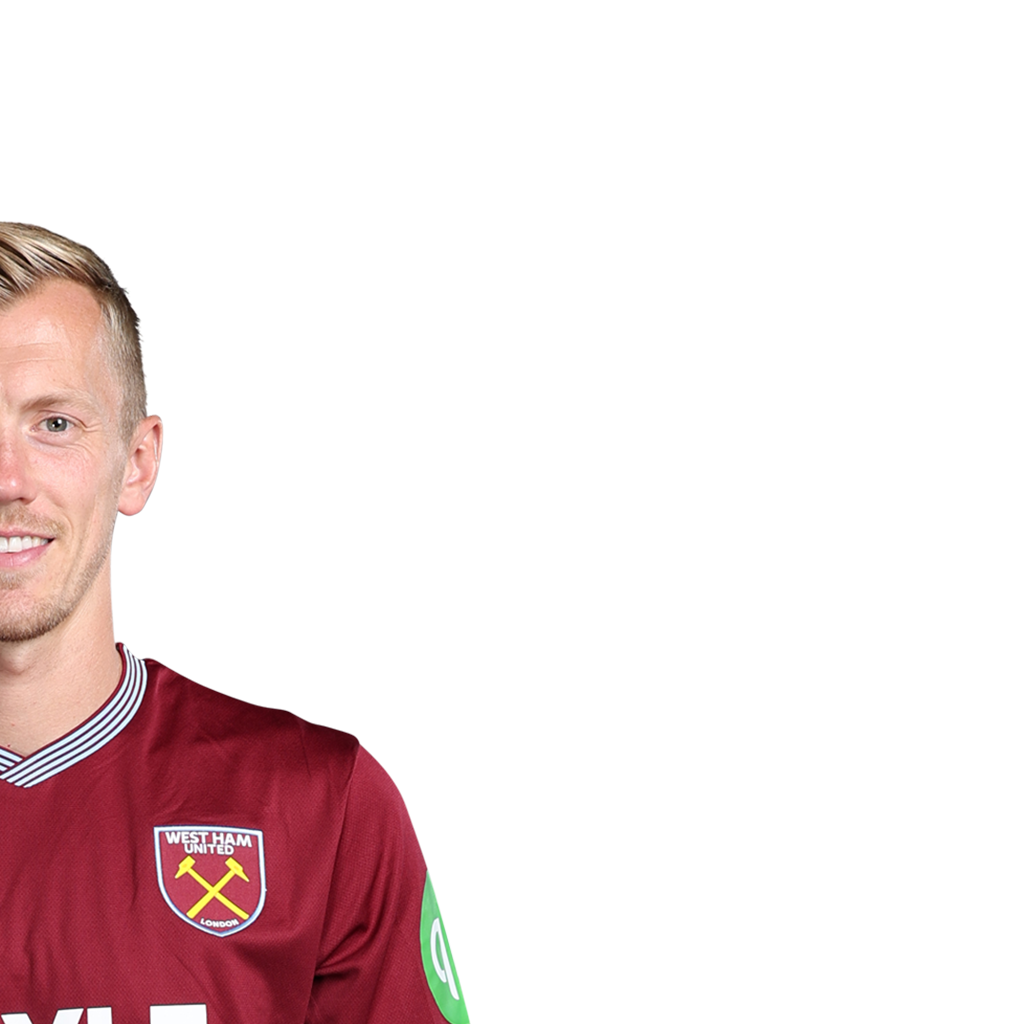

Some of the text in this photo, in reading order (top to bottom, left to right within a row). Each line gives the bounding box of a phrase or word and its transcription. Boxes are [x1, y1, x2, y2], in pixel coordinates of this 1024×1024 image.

[165, 831, 252, 848] WEST HAM
[184, 843, 235, 855] UNITED
[200, 917, 240, 928] LONDON
